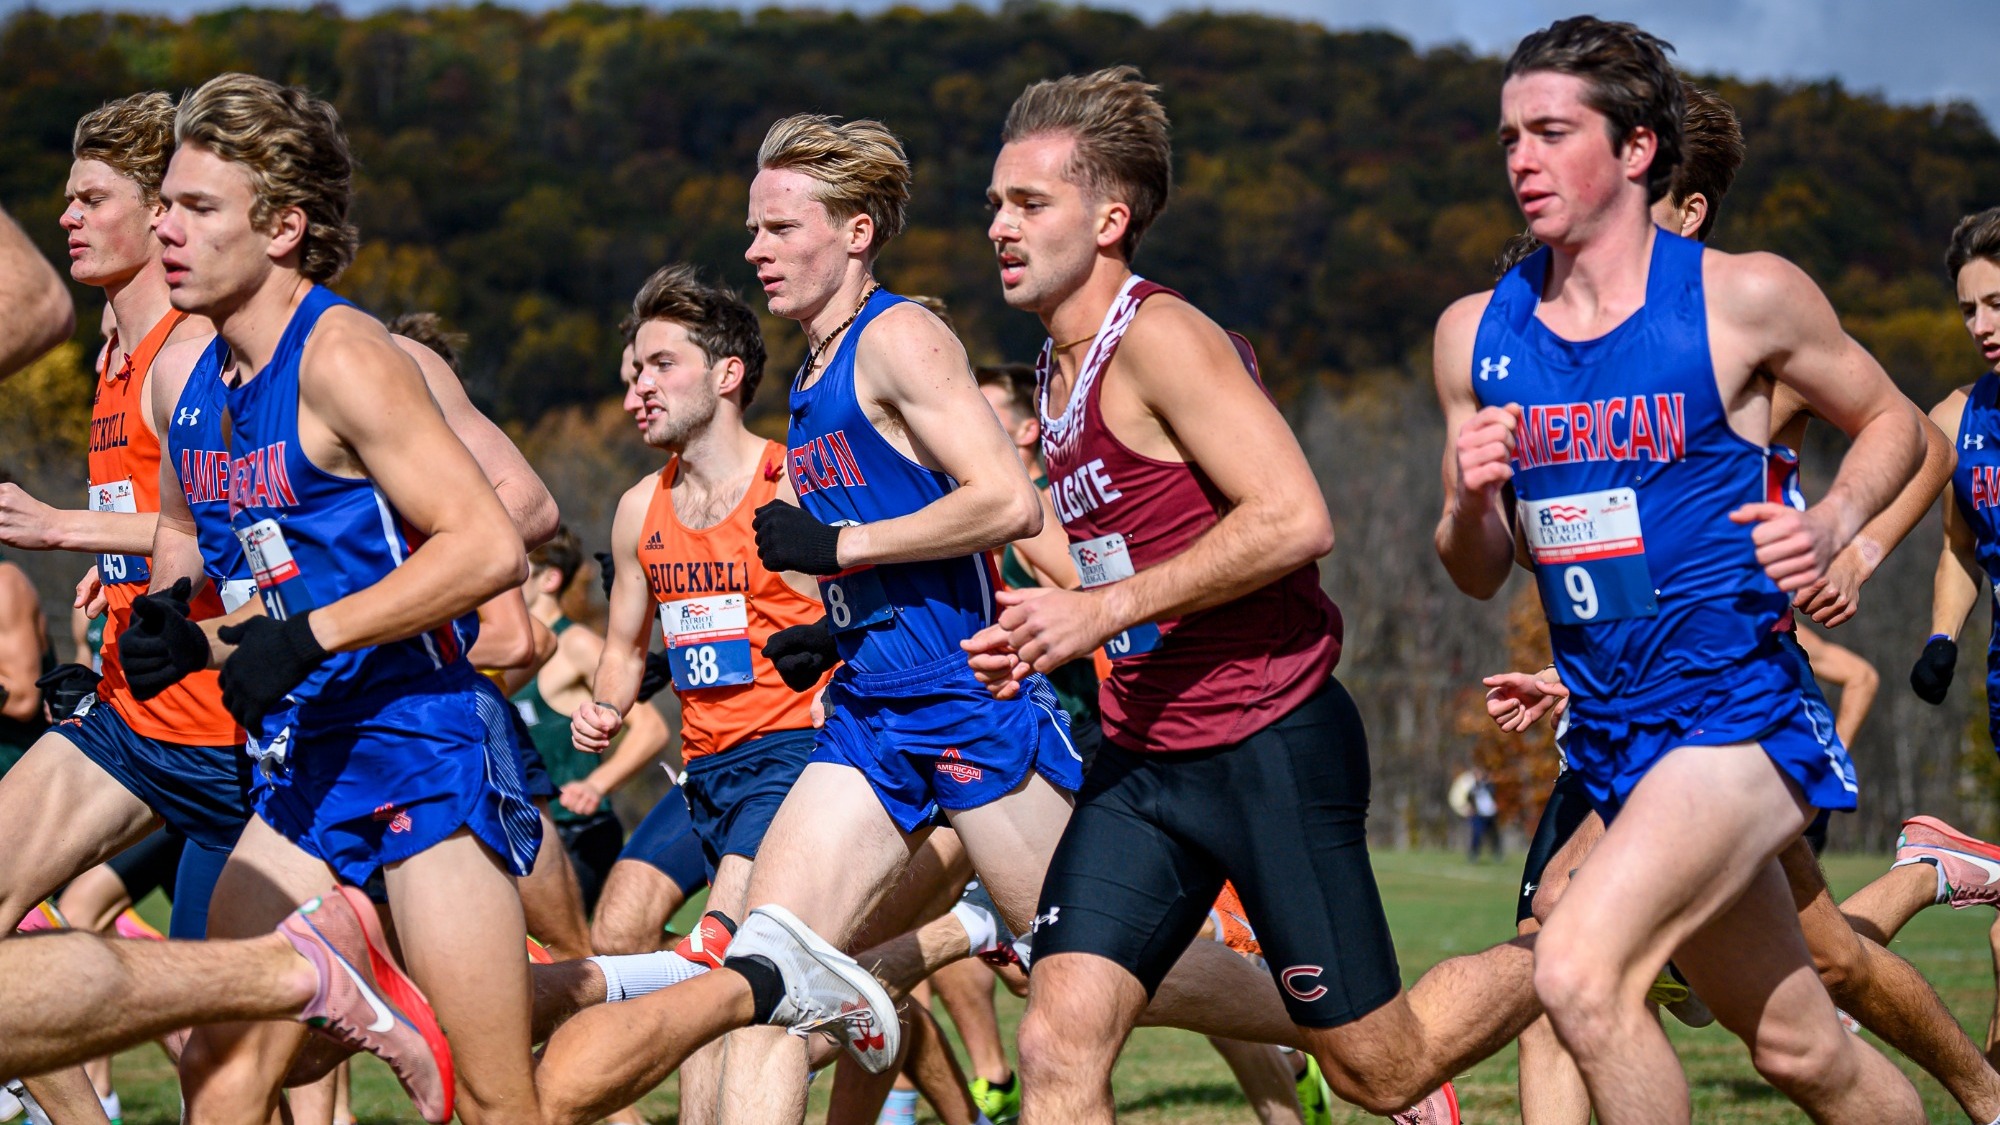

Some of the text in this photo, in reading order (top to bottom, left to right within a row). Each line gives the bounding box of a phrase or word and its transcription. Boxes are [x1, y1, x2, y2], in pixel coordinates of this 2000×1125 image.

[1509, 392, 1686, 471] MERICAN
[1049, 458, 1123, 525] LGATE
[1540, 521, 1595, 535] PATRIOT
[1541, 531, 1598, 545] LEAGUE
[103, 553, 127, 580] 45
[828, 584, 851, 628] 8
[1564, 565, 1599, 620] 9
[680, 615, 713, 626] PATRIOT
[680, 622, 714, 632] LEAGUE
[685, 645, 719, 686] 38
[936, 764, 979, 777] AMERICAN
[1281, 965, 1328, 1002] C
